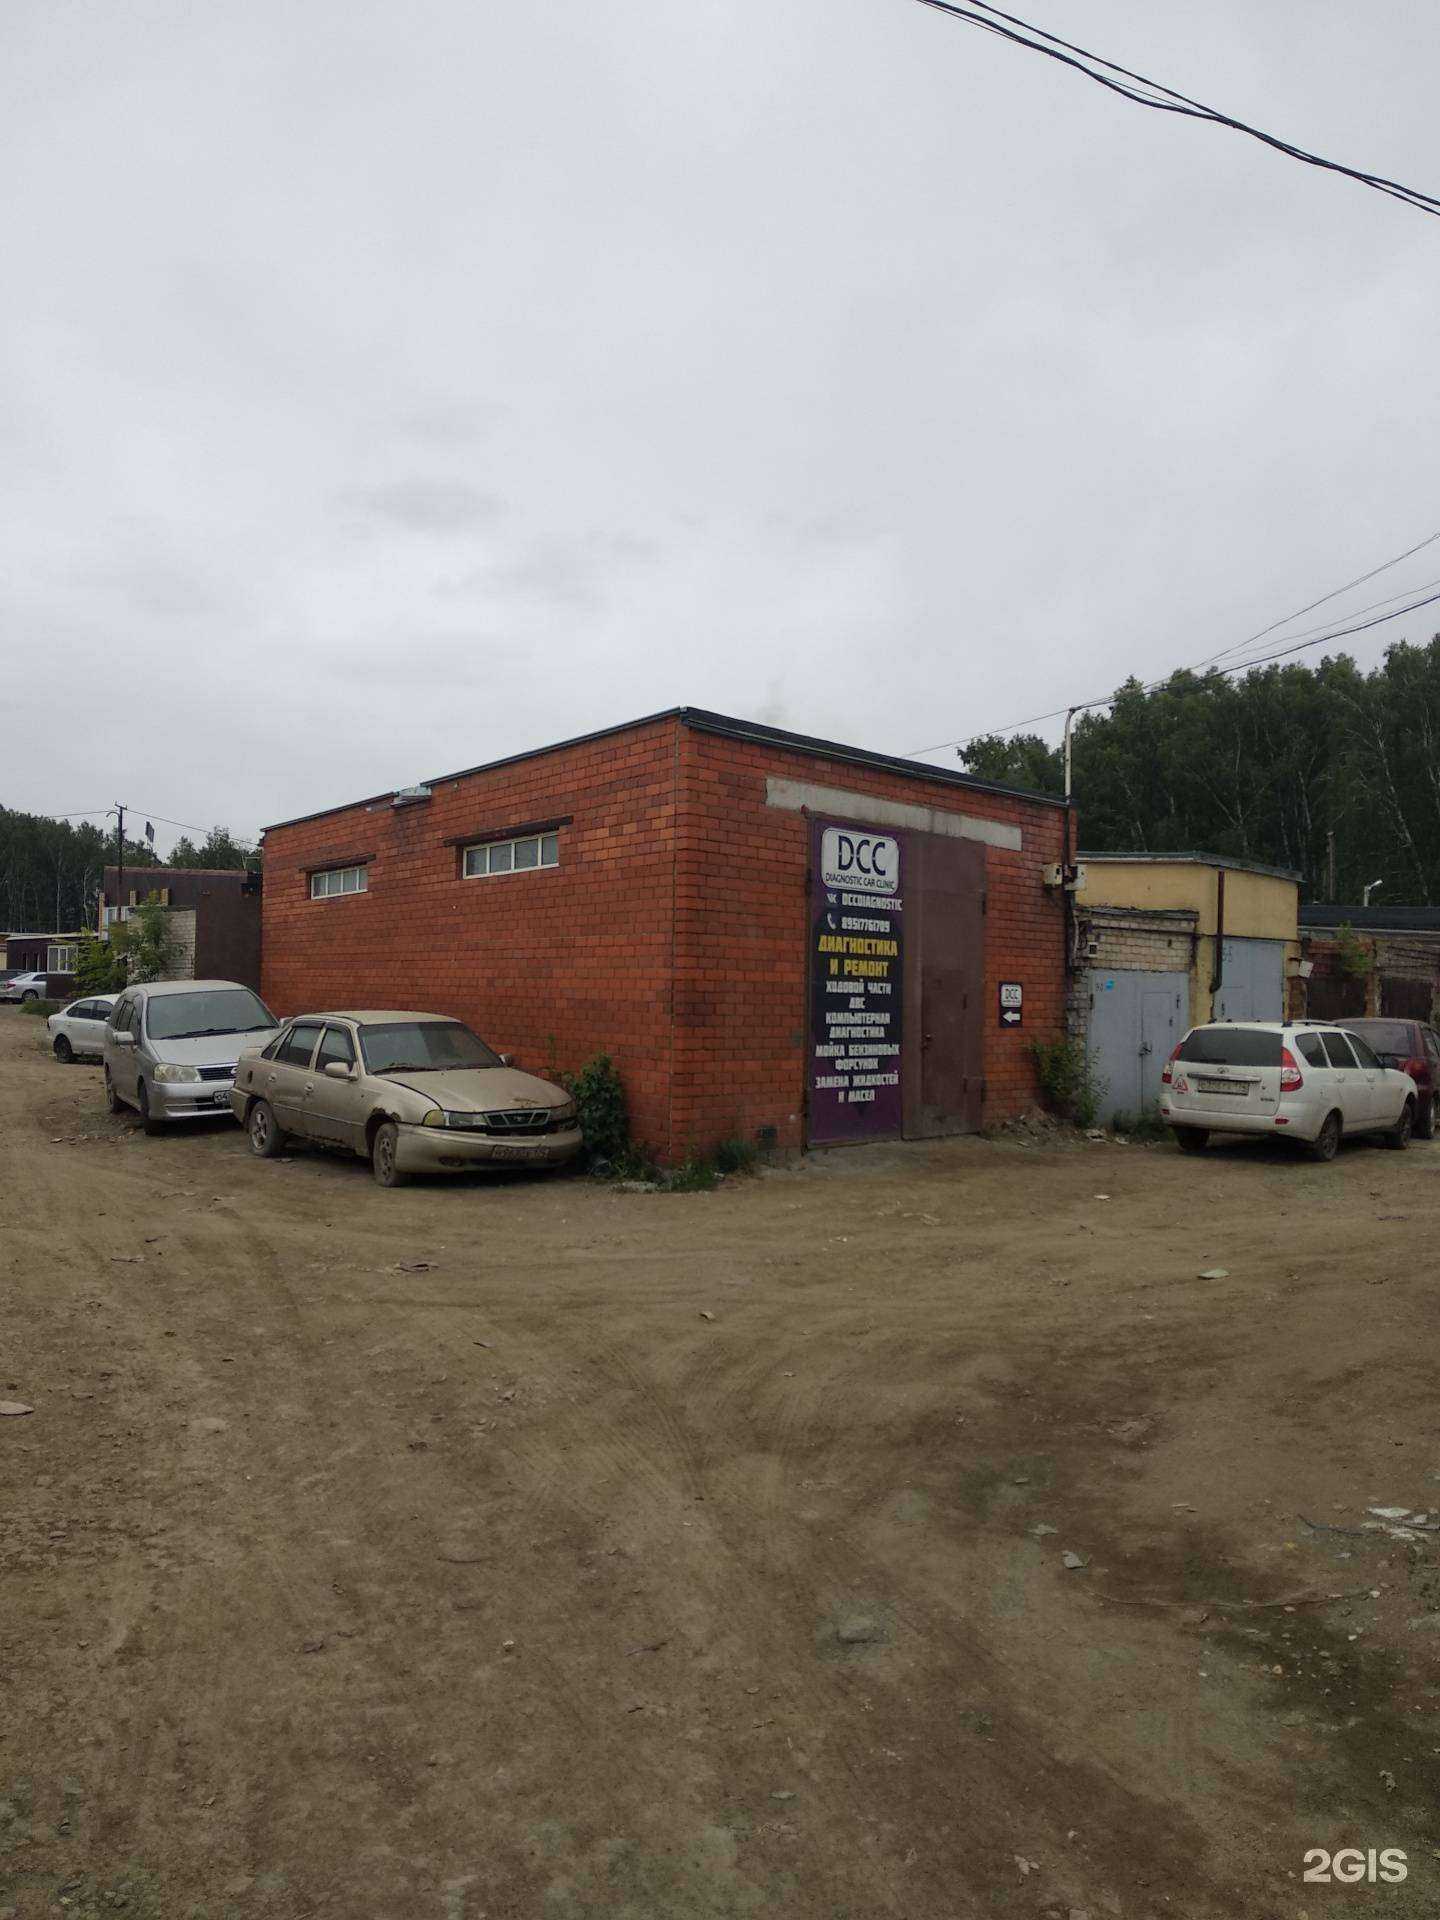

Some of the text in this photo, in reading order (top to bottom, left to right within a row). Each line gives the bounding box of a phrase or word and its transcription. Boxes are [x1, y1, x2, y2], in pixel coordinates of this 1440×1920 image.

[838, 835, 886, 876] DCC
[825, 873, 895, 889] DIAGNOSTIC CAR CLINIC
[842, 893, 902, 911] DCCDIAGNOSTIC
[818, 935, 898, 956] ДИАГНОСТИКА
[829, 959, 889, 977] И РЕМОНТ
[826, 979, 892, 994] ХОДОВОЙ ЧАСТИ
[849, 997, 866, 1009] ДВС
[825, 1012, 891, 1025] КОМПЬЮТЕРНАЯ
[829, 1026, 885, 1038] ДИАГНОСТИКА
[815, 1041, 900, 1057] МОЙКА БЕНЗИНОВЫХ
[835, 1058, 879, 1071] ФОРСУНОК
[815, 1070, 899, 1089] ЗАМЕНА ЖИДКОСТЕЙ
[838, 1089, 876, 1103] И МАСЕЛ
